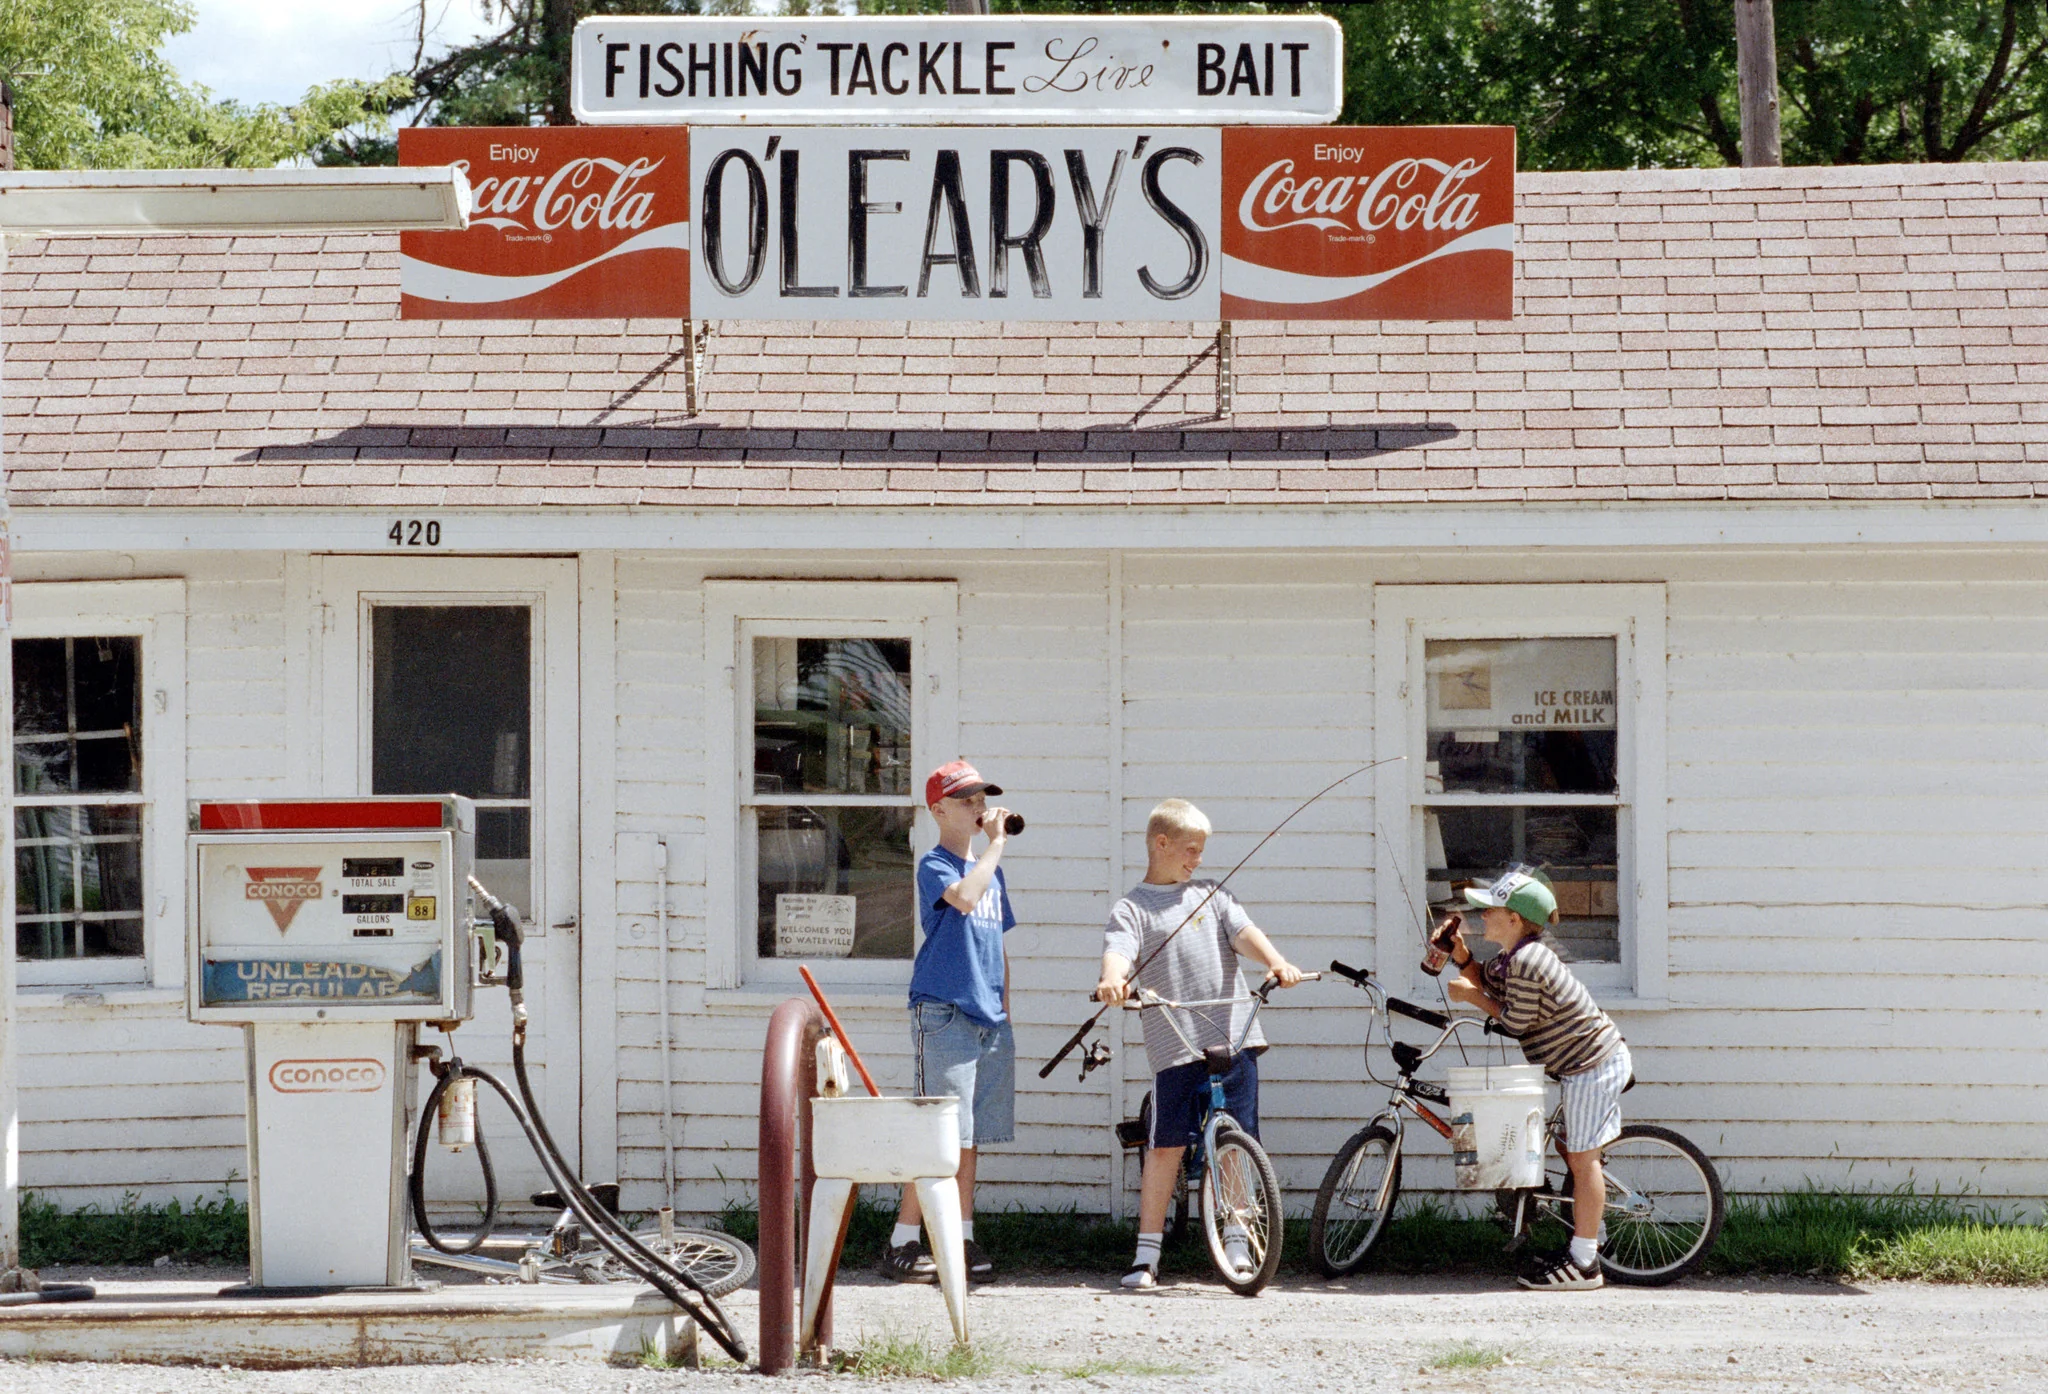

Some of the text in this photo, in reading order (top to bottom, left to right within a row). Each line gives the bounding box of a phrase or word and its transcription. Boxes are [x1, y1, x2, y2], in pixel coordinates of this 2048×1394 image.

[604, 37, 1310, 98] FISHING TACKLE Live BAIT
[489, 143, 540, 163] Enjoy
[1313, 143, 1365, 163] Enjoy
[450, 155, 667, 231] ca-Cola
[1238, 156, 1492, 232] Coca-Cola
[702, 135, 1210, 300] O'LEARY'S
[388, 519, 441, 546] 420
[1534, 690, 1613, 706] ICE CREAM
[1511, 708, 1606, 724] and MILK
[247, 884, 320, 898] CONOCO
[351, 878, 397, 888] TOTAL SALE
[356, 914, 391, 924] GALLONS
[414, 905, 429, 917] 88
[780, 925, 852, 936] WELCOMES YOU
[779, 936, 852, 946] TO WATERVILLE
[280, 1067, 377, 1084] conoco
